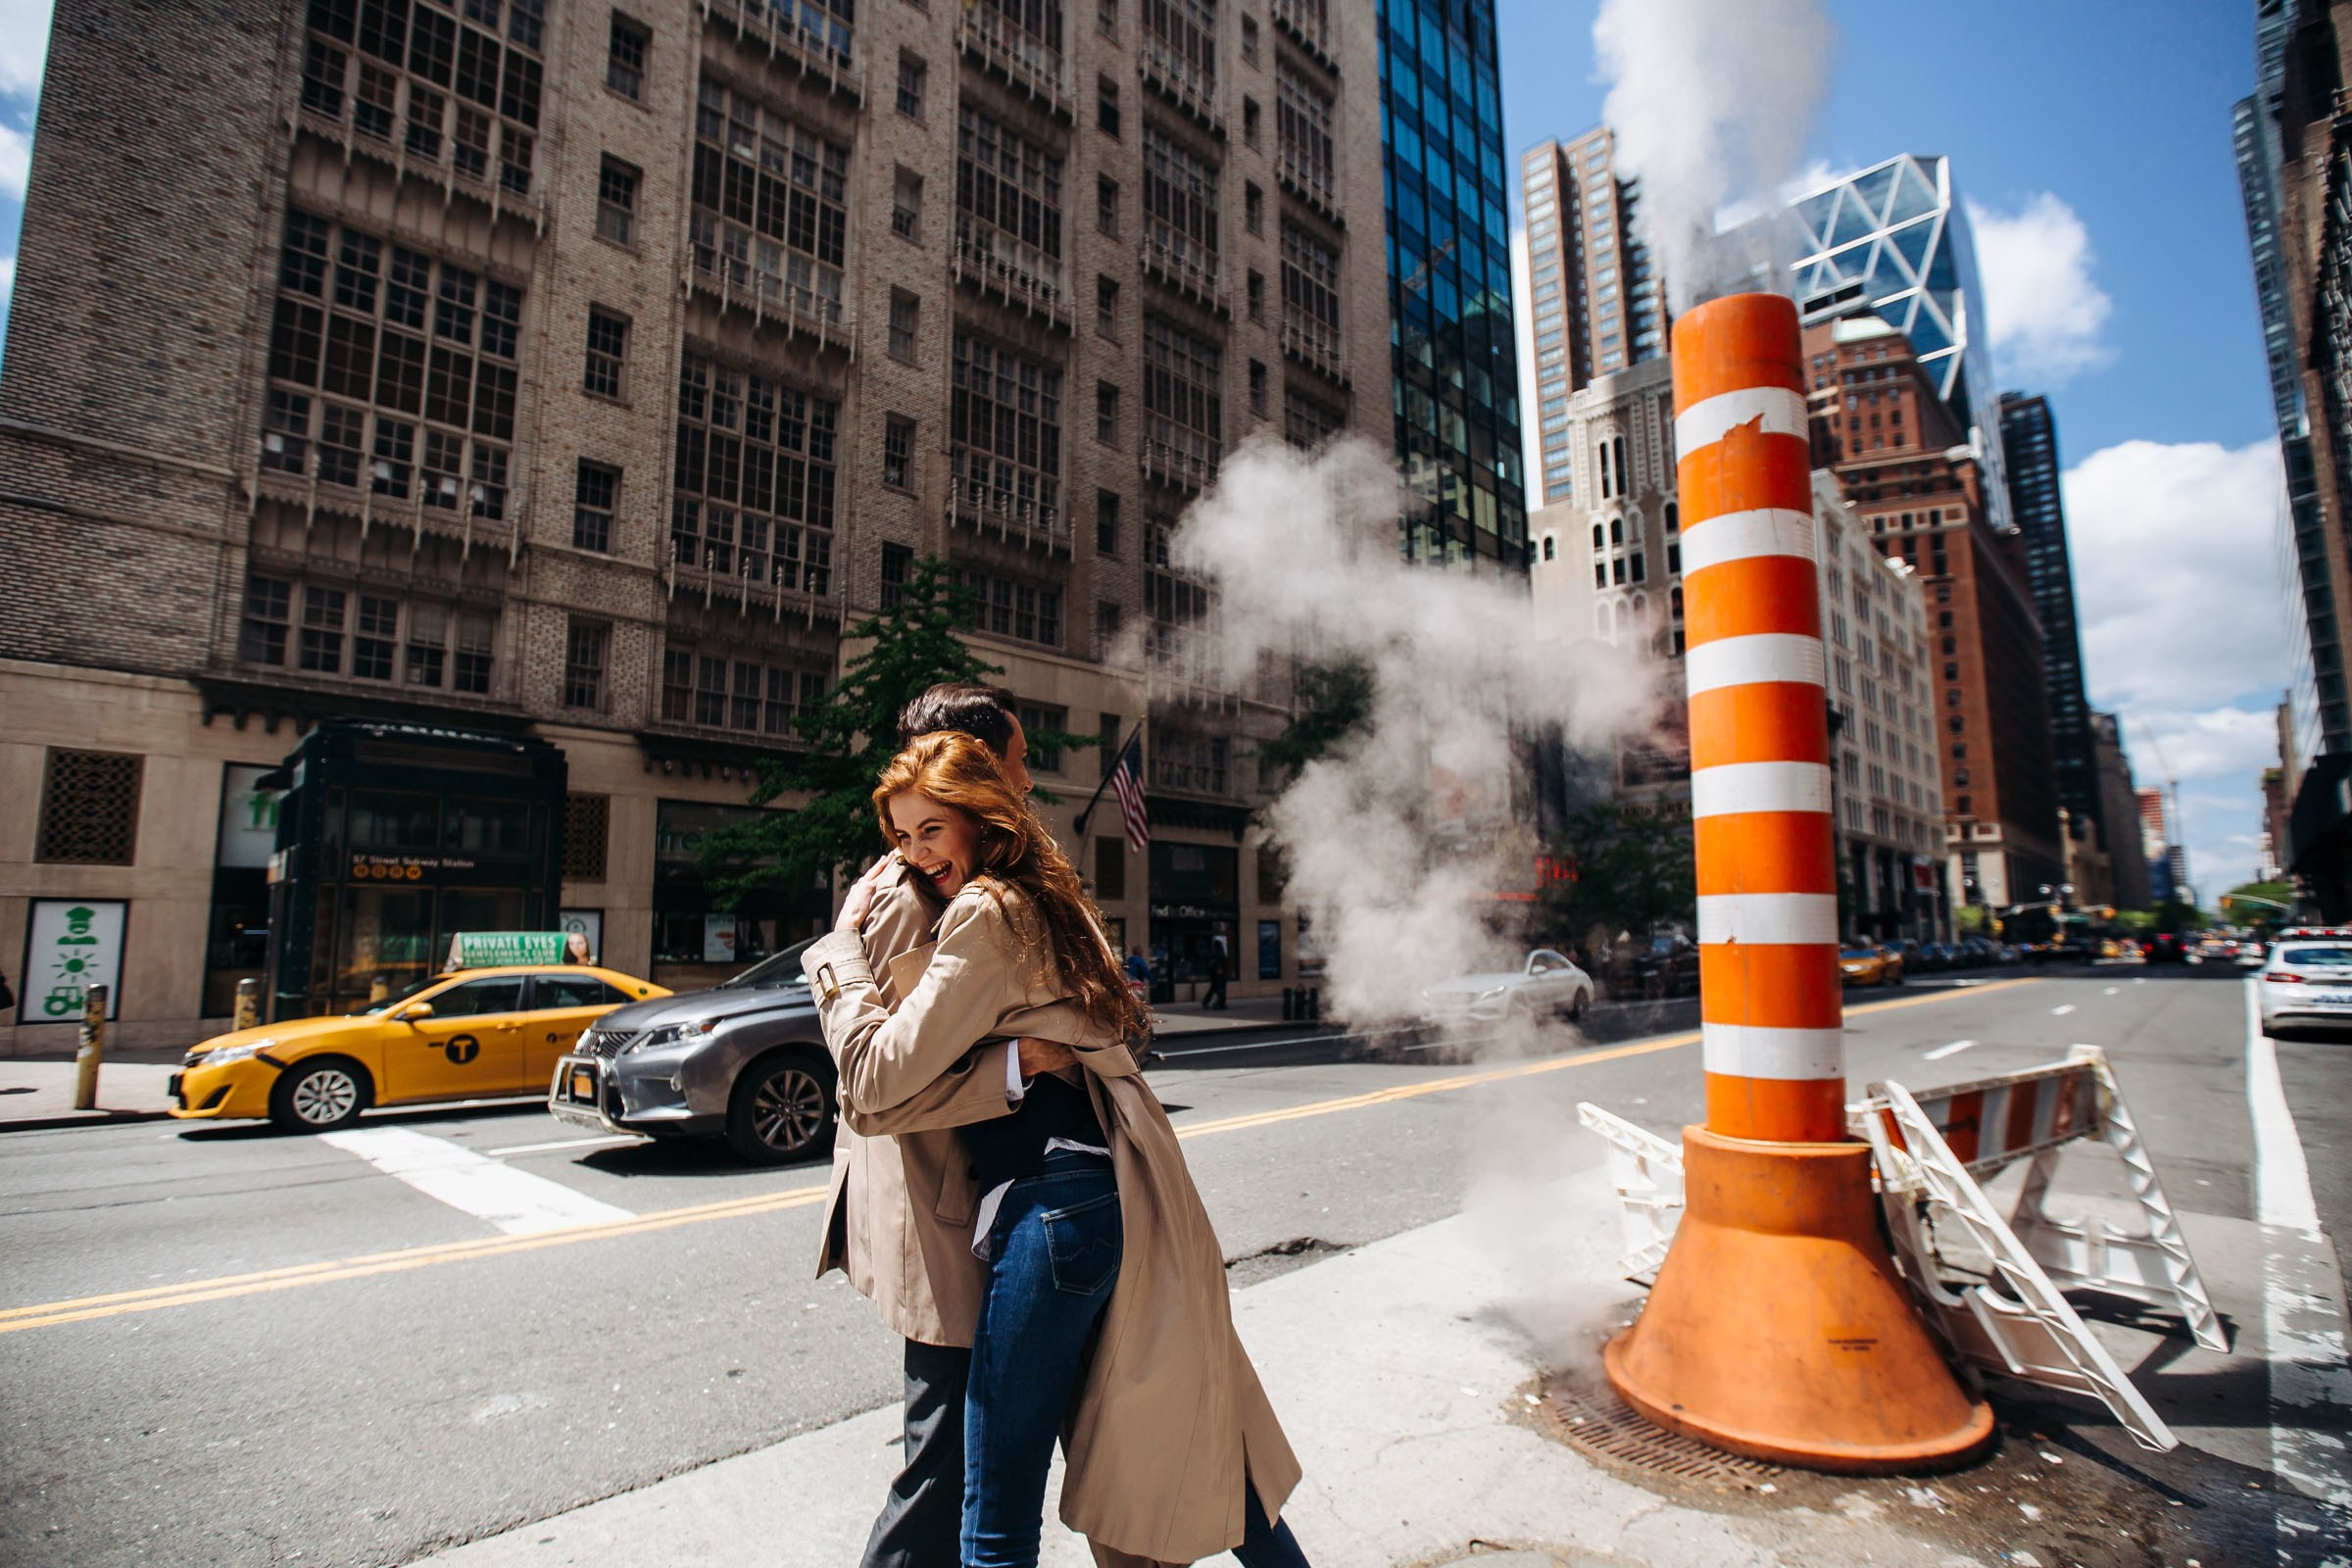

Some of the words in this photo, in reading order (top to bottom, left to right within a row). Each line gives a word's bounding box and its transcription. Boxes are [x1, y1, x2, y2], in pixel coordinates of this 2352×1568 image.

[369, 856, 399, 866] Street
[403, 857, 439, 869] Subway
[441, 858, 475, 869] Station
[464, 936, 519, 950] PRIVATE
[524, 935, 556, 950] EYES
[532, 949, 556, 957] CLUB
[453, 1039, 471, 1060] T
